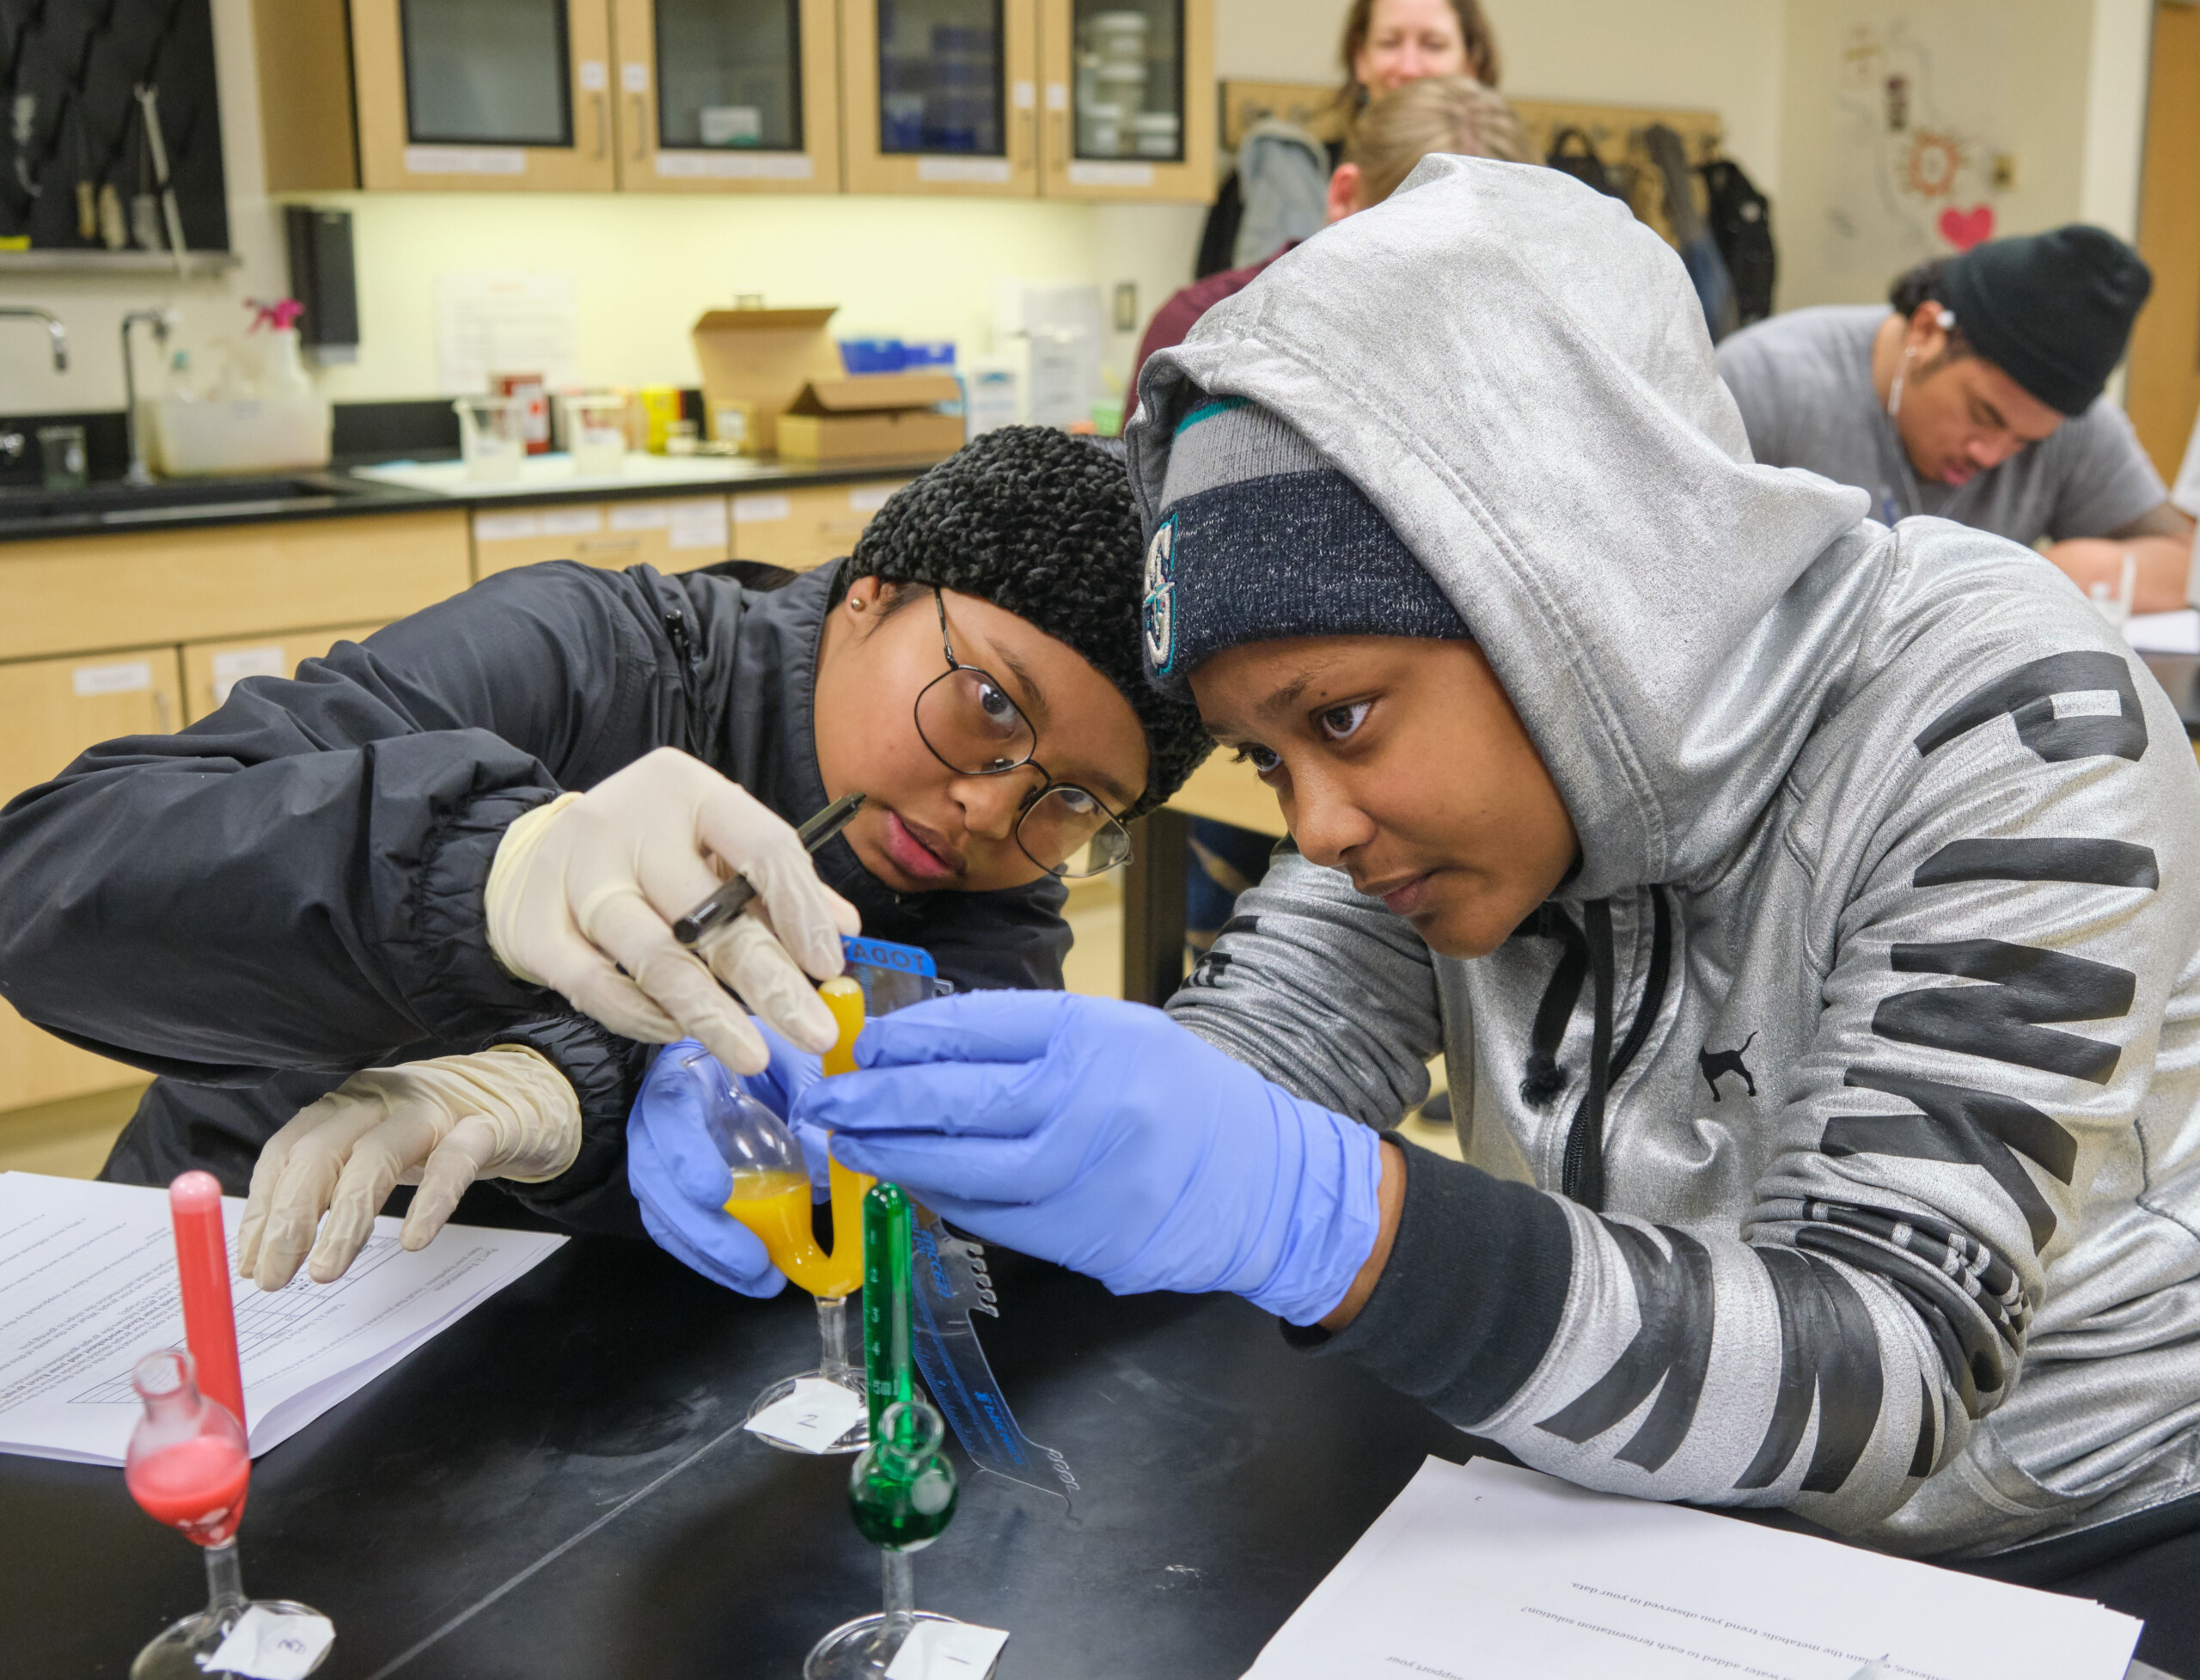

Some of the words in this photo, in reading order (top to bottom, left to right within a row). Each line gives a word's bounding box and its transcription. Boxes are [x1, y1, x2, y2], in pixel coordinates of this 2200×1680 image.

[1821, 650, 2160, 1252] PINK
[870, 1266, 879, 1283] 2
[871, 1305, 881, 1323] 3
[871, 1341, 882, 1356] 4
[798, 1414, 819, 1430] 2
[1570, 1581, 1599, 1595] data.
[1599, 1589, 1630, 1602] your
[1629, 1597, 1642, 1605] in
[1519, 1604, 1575, 1625] solution?
[1642, 1599, 1698, 1620] observed
[1700, 1614, 1724, 1627] you
[1576, 1620, 1656, 1647] fermentation
[1725, 1621, 1758, 1636] trend
[1656, 1640, 1686, 1655] each
[1759, 1631, 1820, 1653] metabolic
[1686, 1649, 1702, 1660] to
[1823, 1646, 1843, 1659] the
[1384, 1654, 1417, 1668] your
[1702, 1653, 1742, 1671] added
[1847, 1653, 1891, 1670] elain
